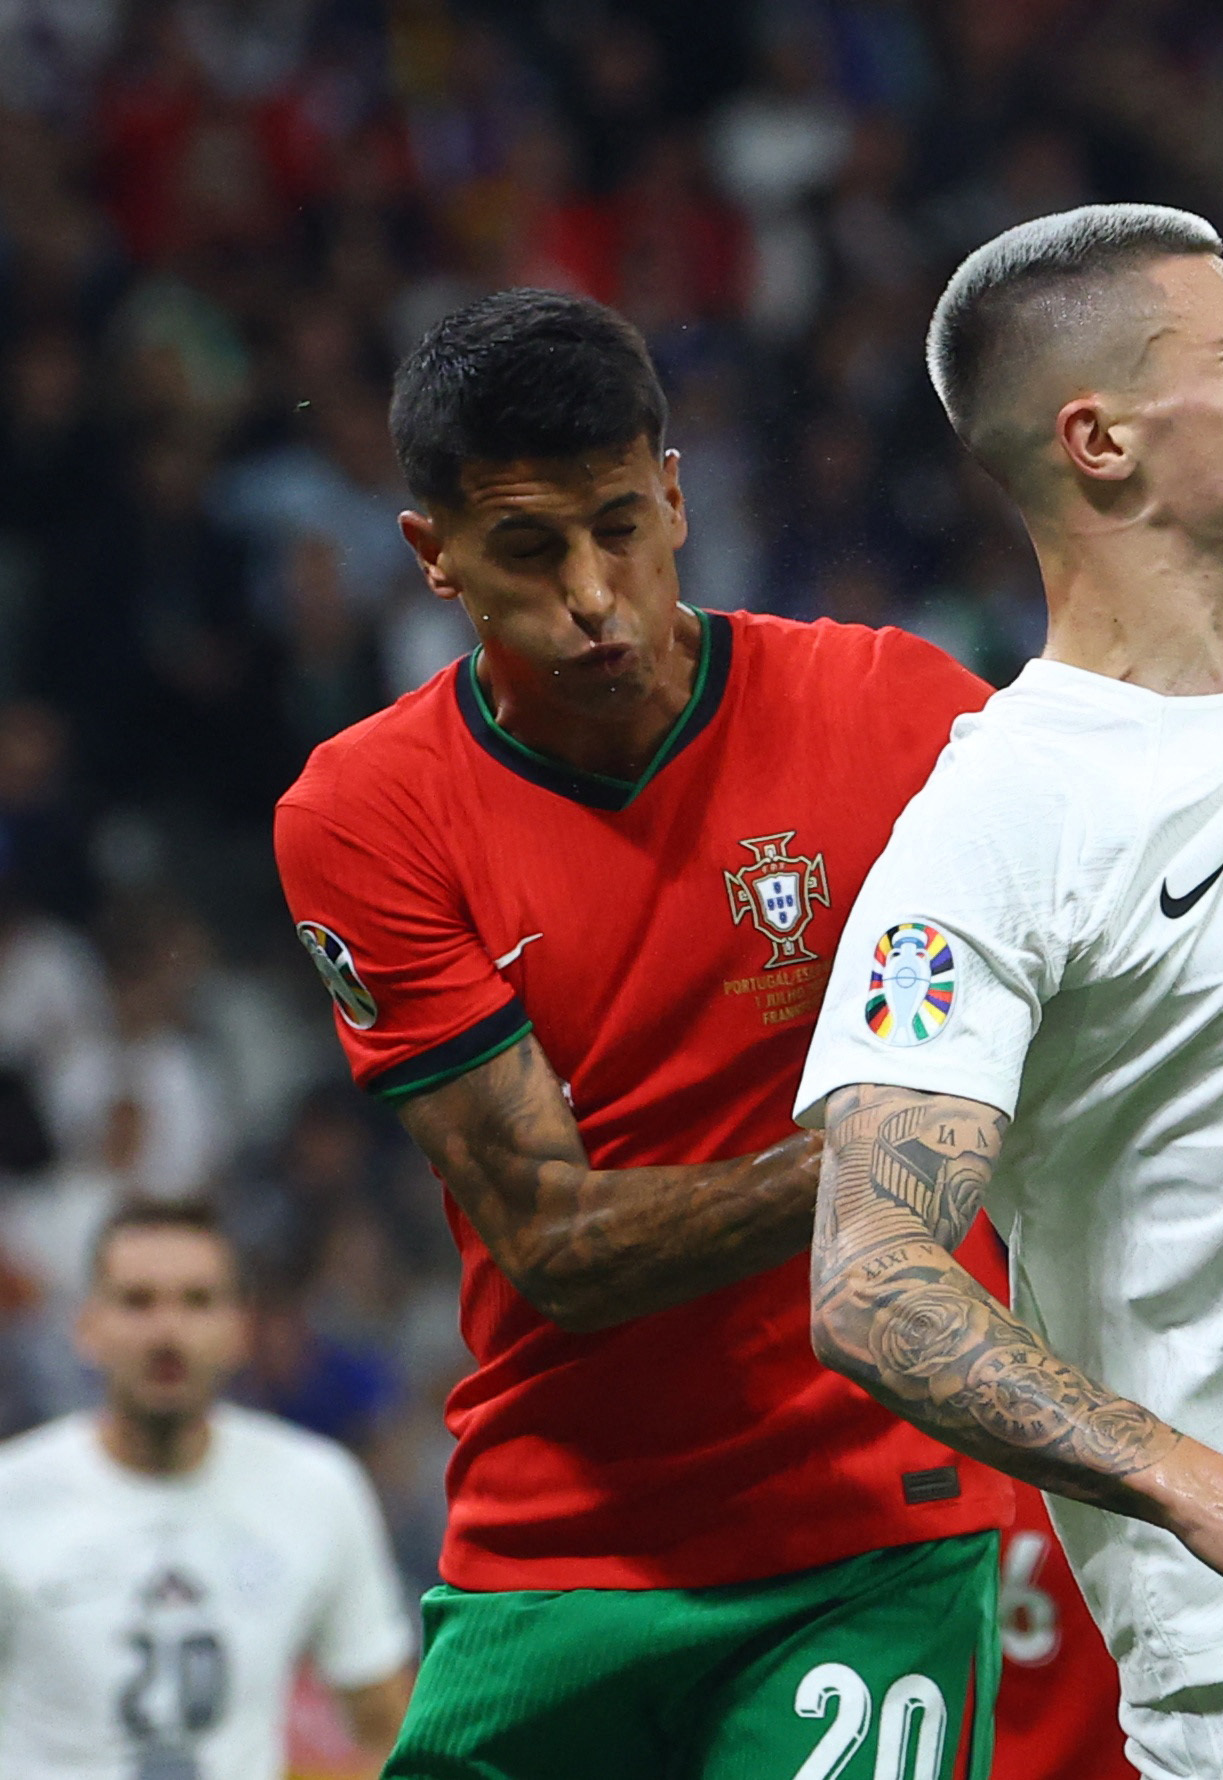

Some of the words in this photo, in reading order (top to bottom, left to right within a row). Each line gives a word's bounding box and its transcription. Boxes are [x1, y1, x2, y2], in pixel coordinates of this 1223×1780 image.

[723, 970, 794, 995] PORTUGAL
[1000, 1531, 1062, 1666] 6
[116, 1627, 232, 1740] 20
[794, 1662, 947, 1780] 20
